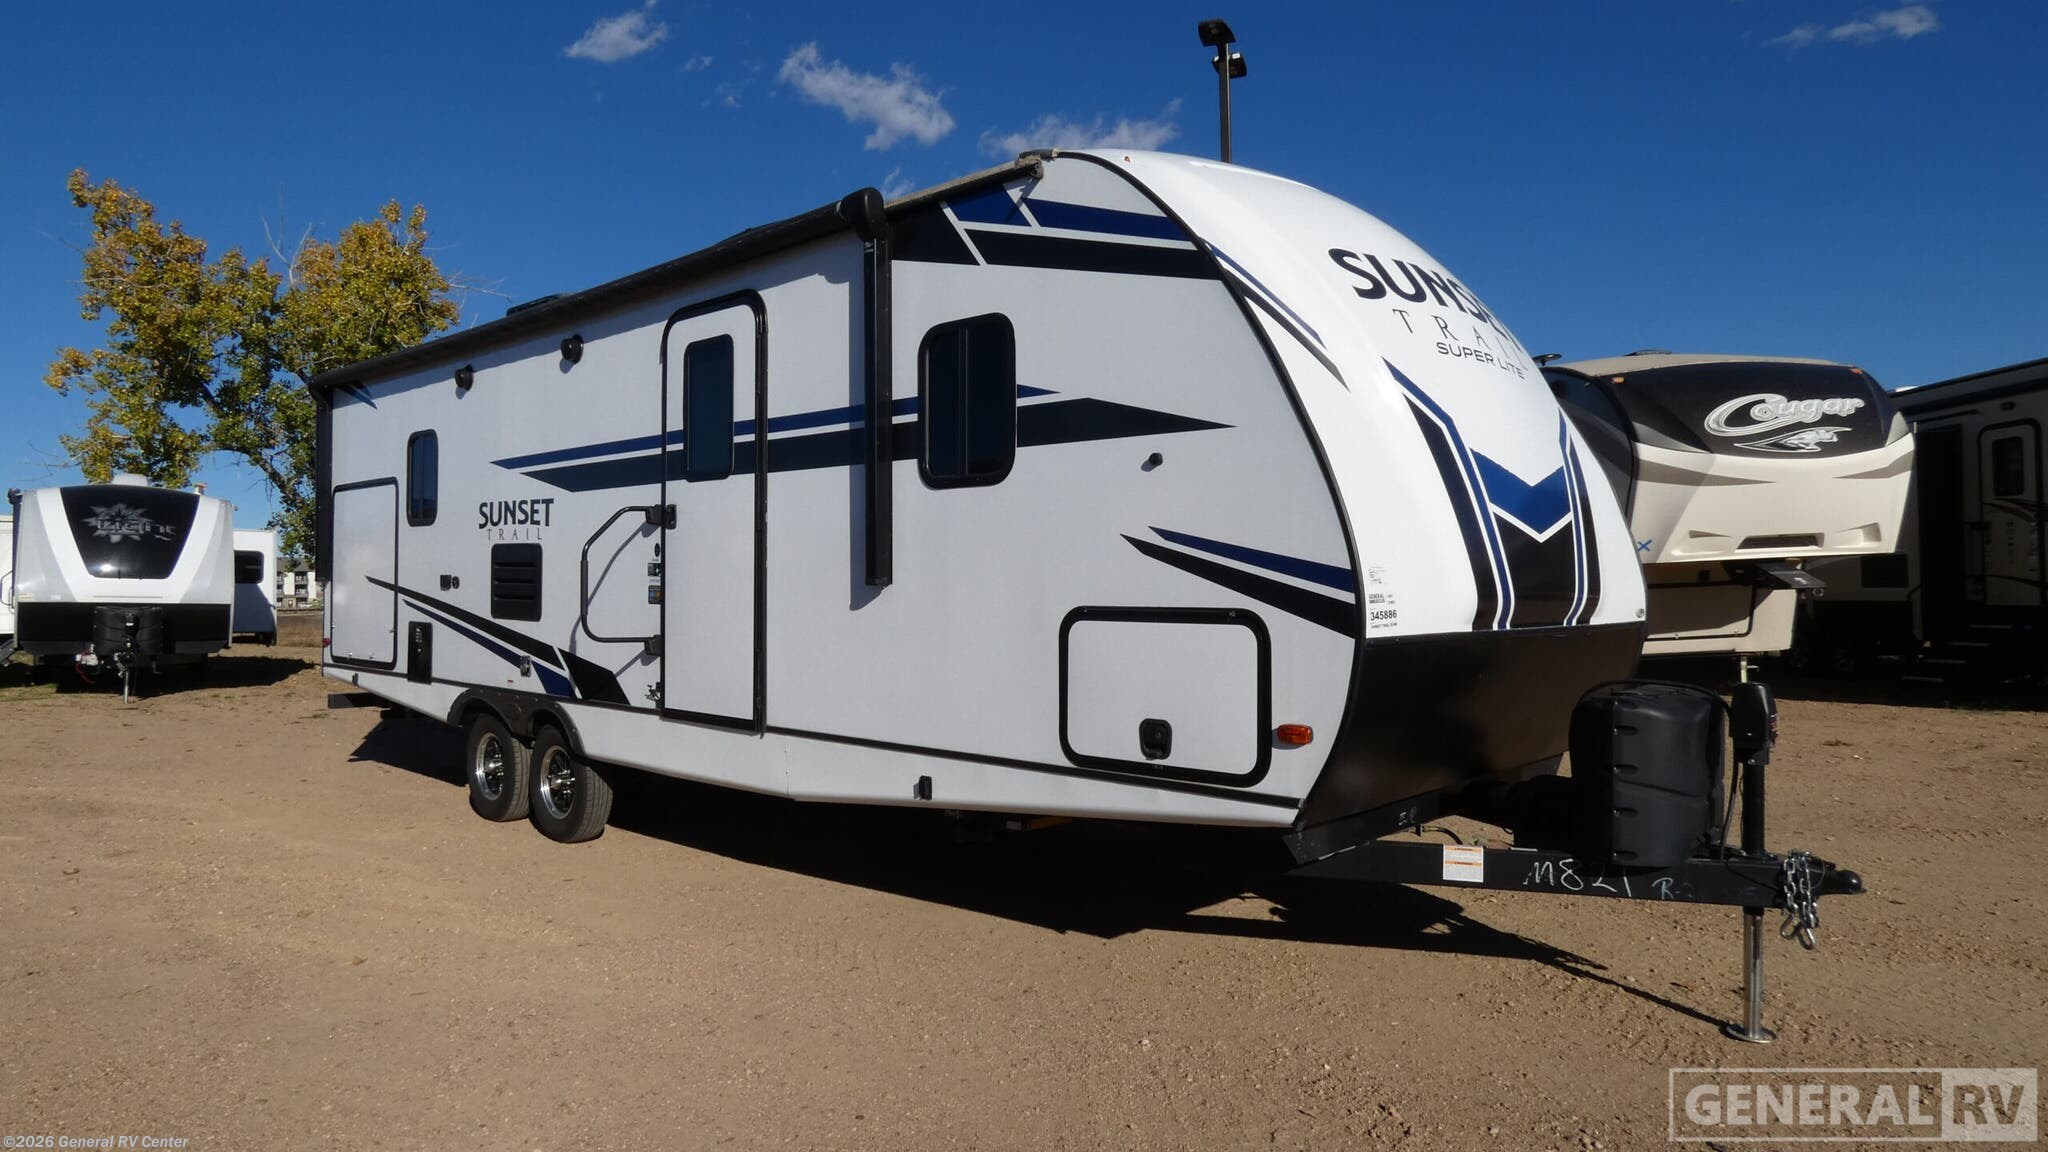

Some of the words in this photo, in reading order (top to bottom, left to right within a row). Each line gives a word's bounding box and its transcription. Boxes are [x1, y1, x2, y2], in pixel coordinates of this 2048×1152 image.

[1392, 308, 1528, 371] TRAIL
[1436, 341, 1495, 366] SUPER
[1497, 357, 1526, 380] LITE
[1704, 392, 1866, 437] Cougar
[478, 498, 554, 529] SUNSET
[487, 528, 543, 541] TRAIL
